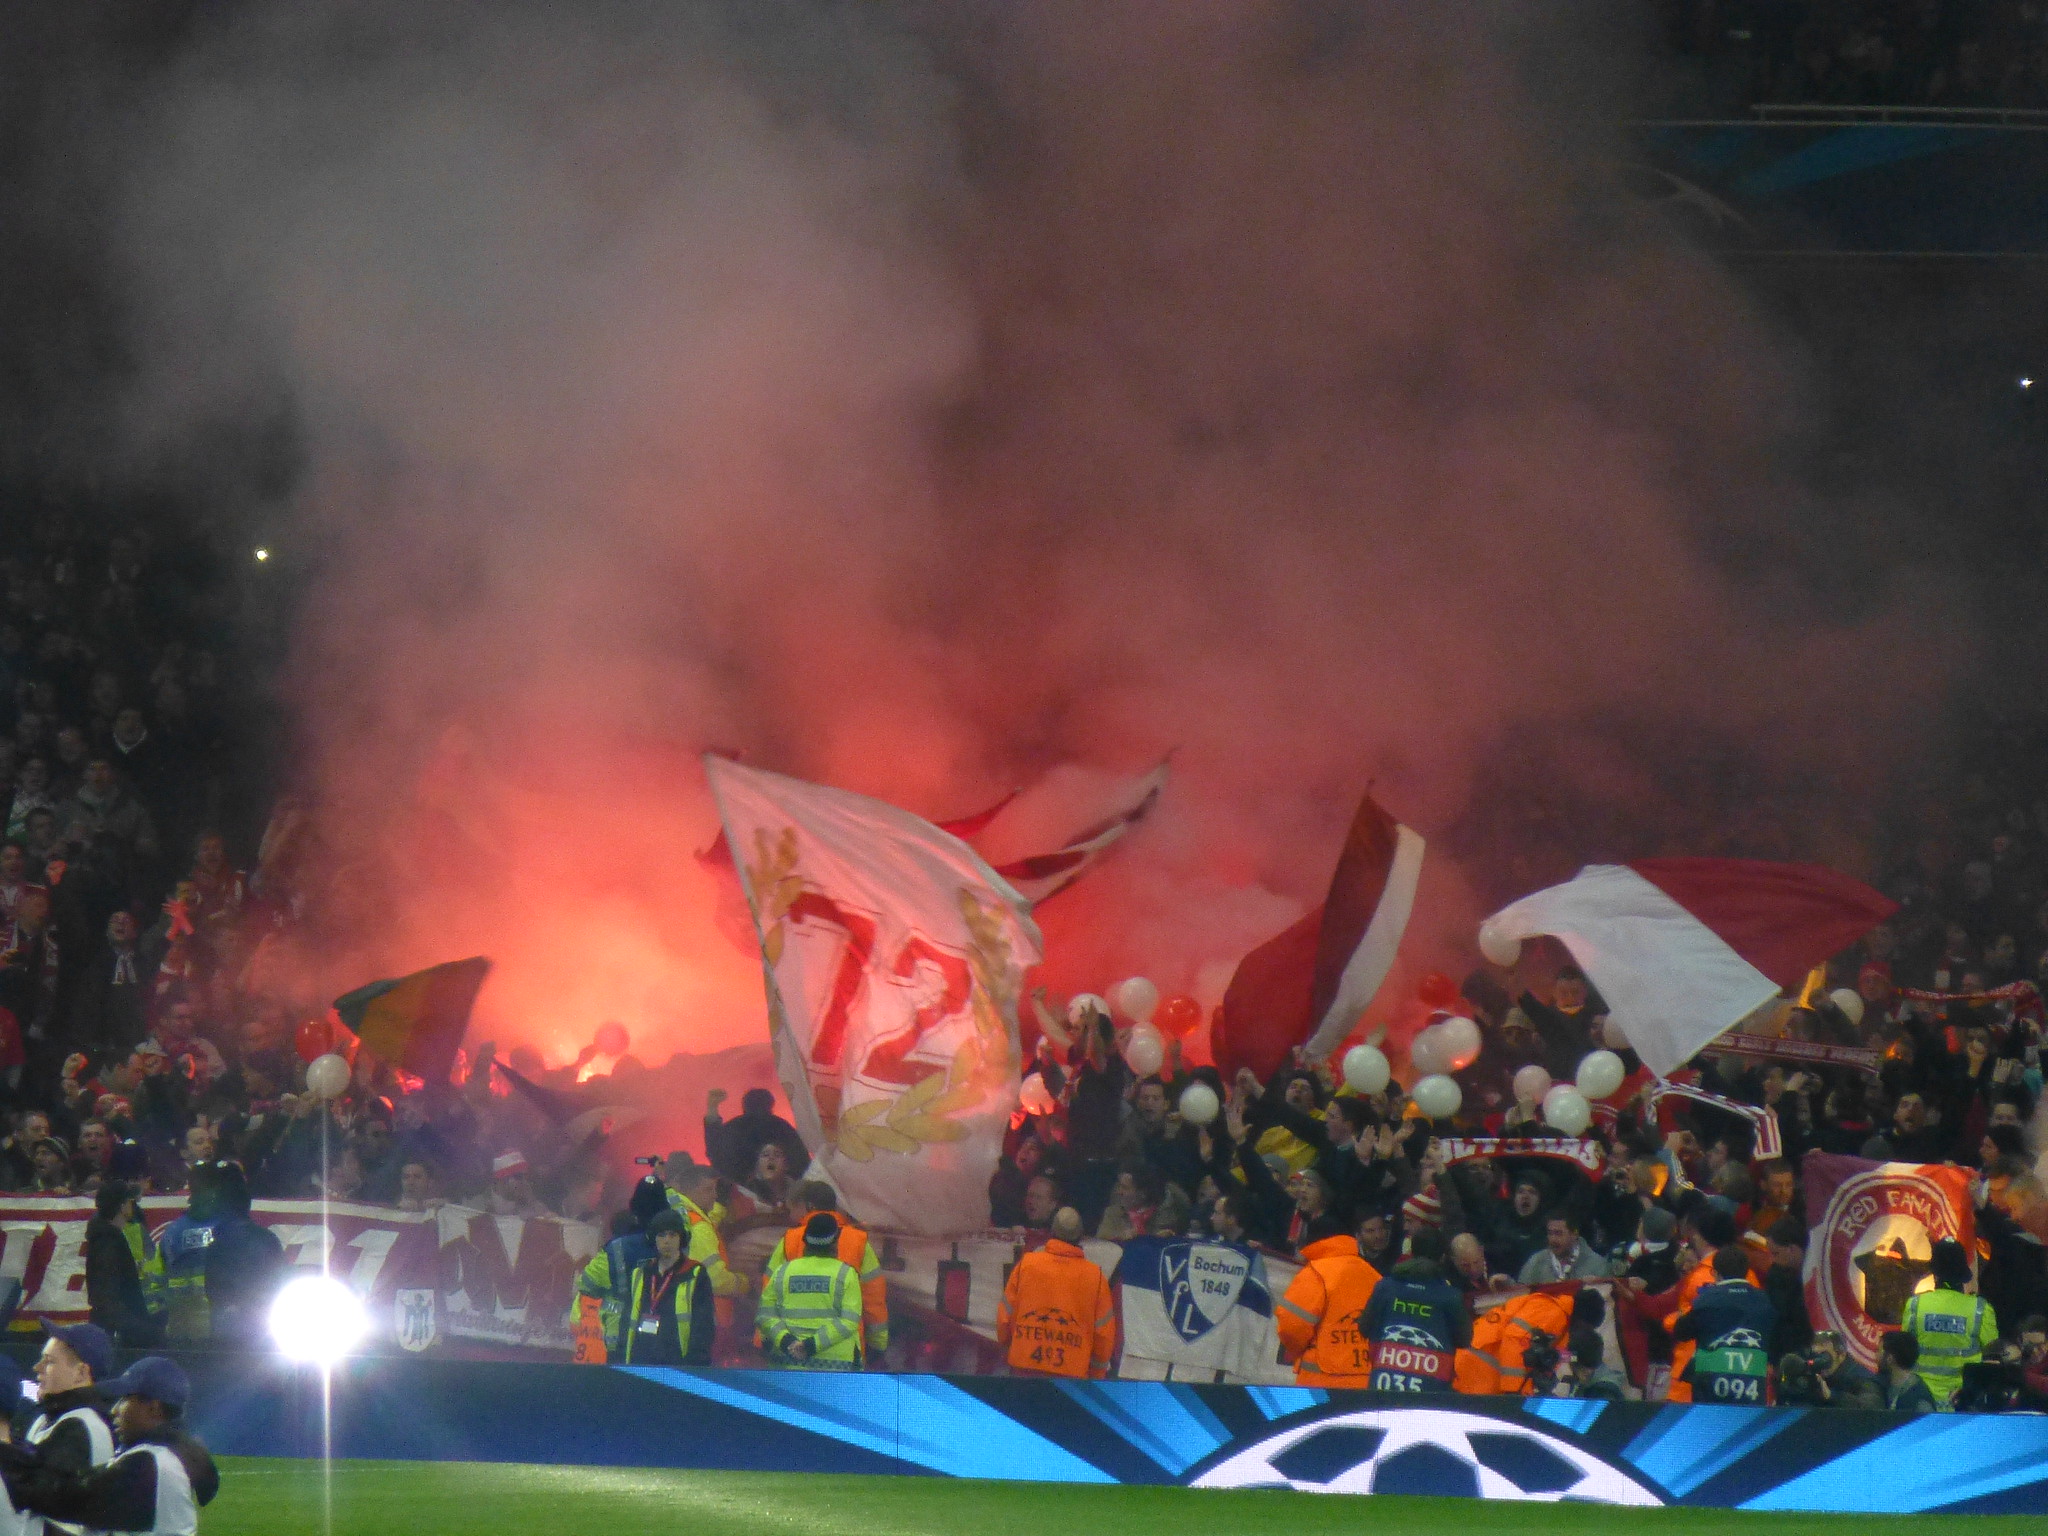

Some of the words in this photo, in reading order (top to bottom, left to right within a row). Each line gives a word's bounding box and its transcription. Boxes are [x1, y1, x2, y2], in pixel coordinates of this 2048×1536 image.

[1193, 1256, 1245, 1277] Bochum
[789, 1280, 830, 1292] POLICE
[1201, 1279, 1231, 1297] 1848
[1015, 1325, 1083, 1348] STEWARD
[1725, 1351, 1754, 1372] TV
[1713, 1377, 1760, 1401] 094
